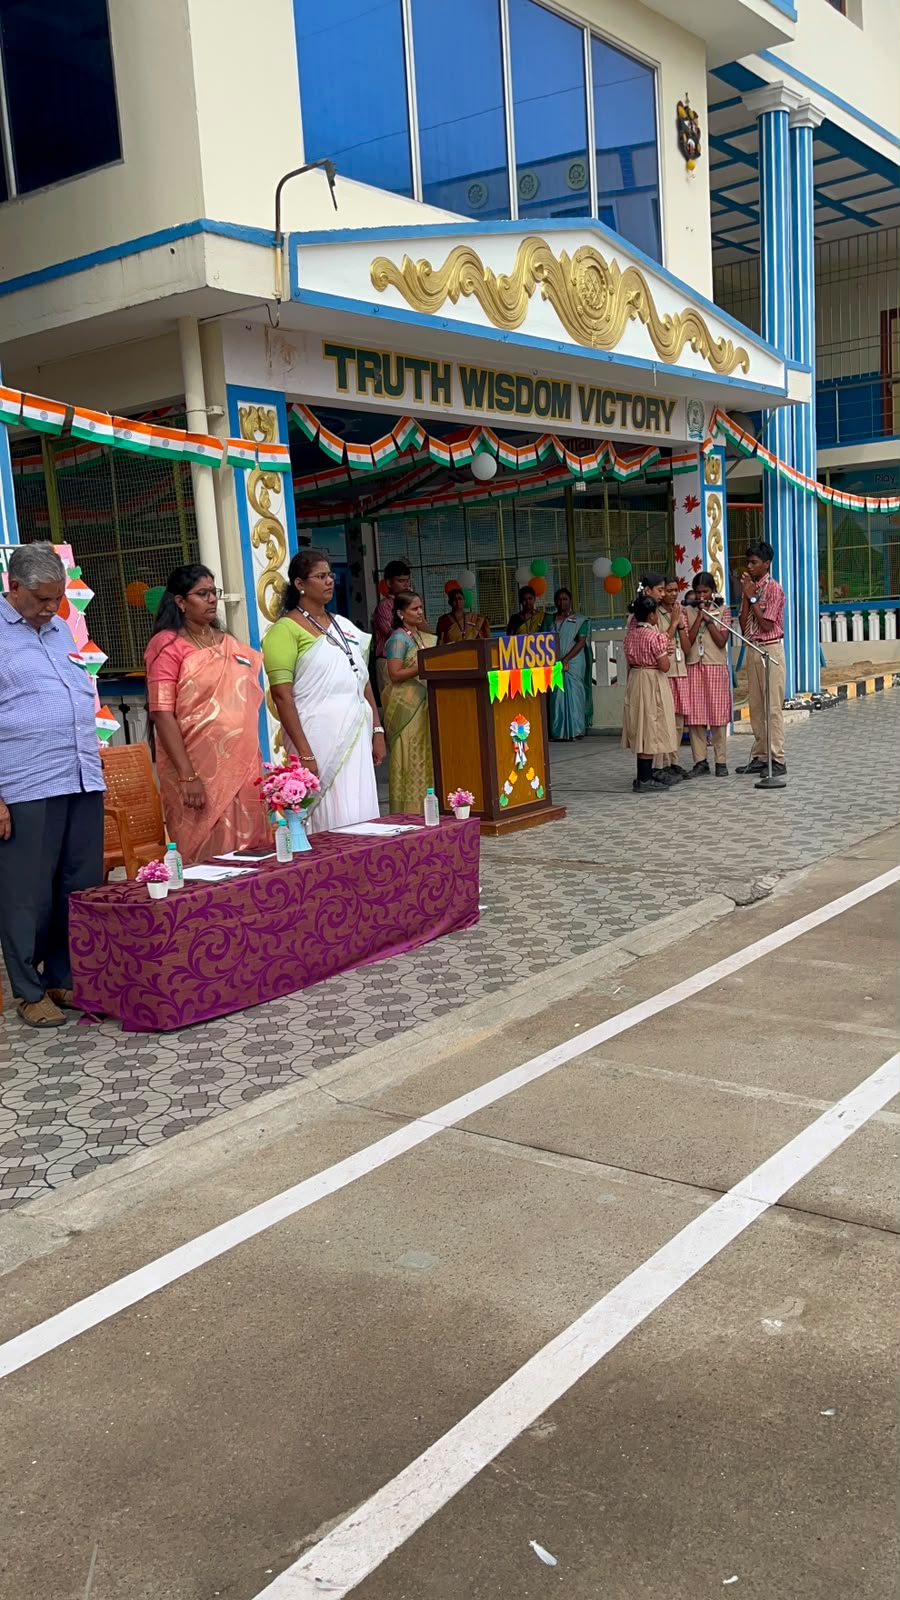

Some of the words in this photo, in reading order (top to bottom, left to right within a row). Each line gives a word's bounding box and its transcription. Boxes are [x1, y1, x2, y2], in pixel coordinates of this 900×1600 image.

[322, 340, 453, 407] TRUTH
[457, 363, 572, 422] WISDOM
[576, 384, 678, 434] VICTORY
[499, 634, 556, 671] MVSSS
